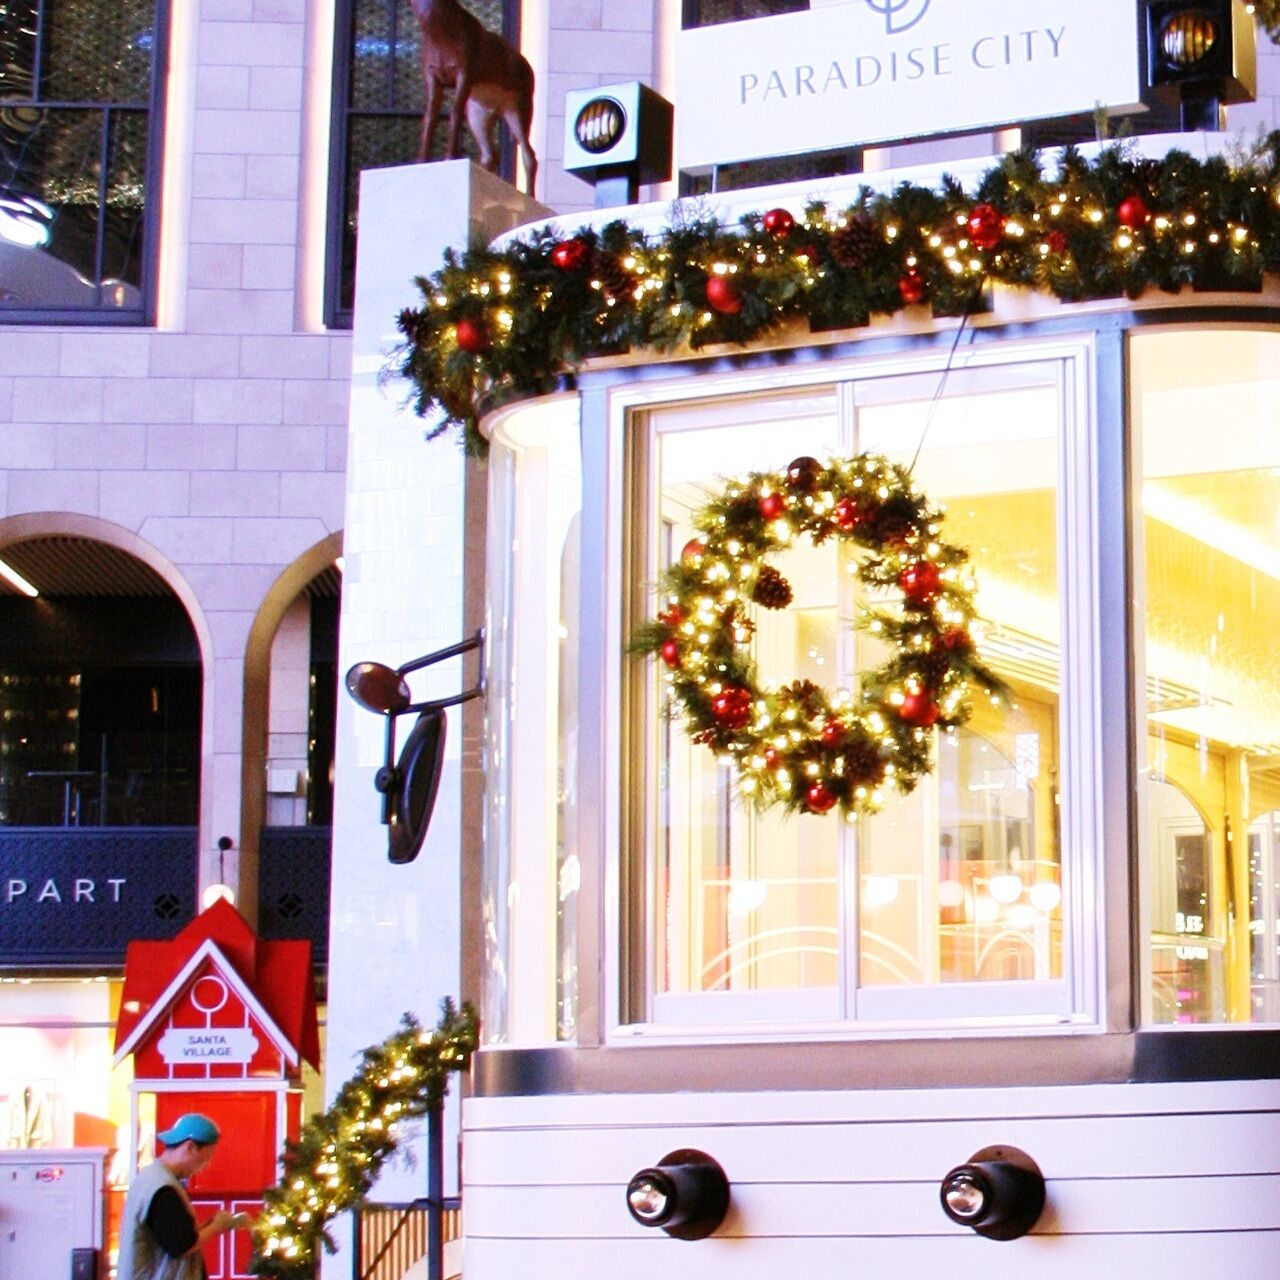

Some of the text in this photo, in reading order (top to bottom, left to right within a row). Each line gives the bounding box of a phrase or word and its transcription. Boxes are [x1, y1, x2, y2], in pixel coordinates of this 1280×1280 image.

[739, 25, 1066, 105] PARADISE CITY
[8, 879, 127, 903] PART
[188, 1035, 227, 1045] SANTA
[182, 1047, 232, 1057] VILLAGE
